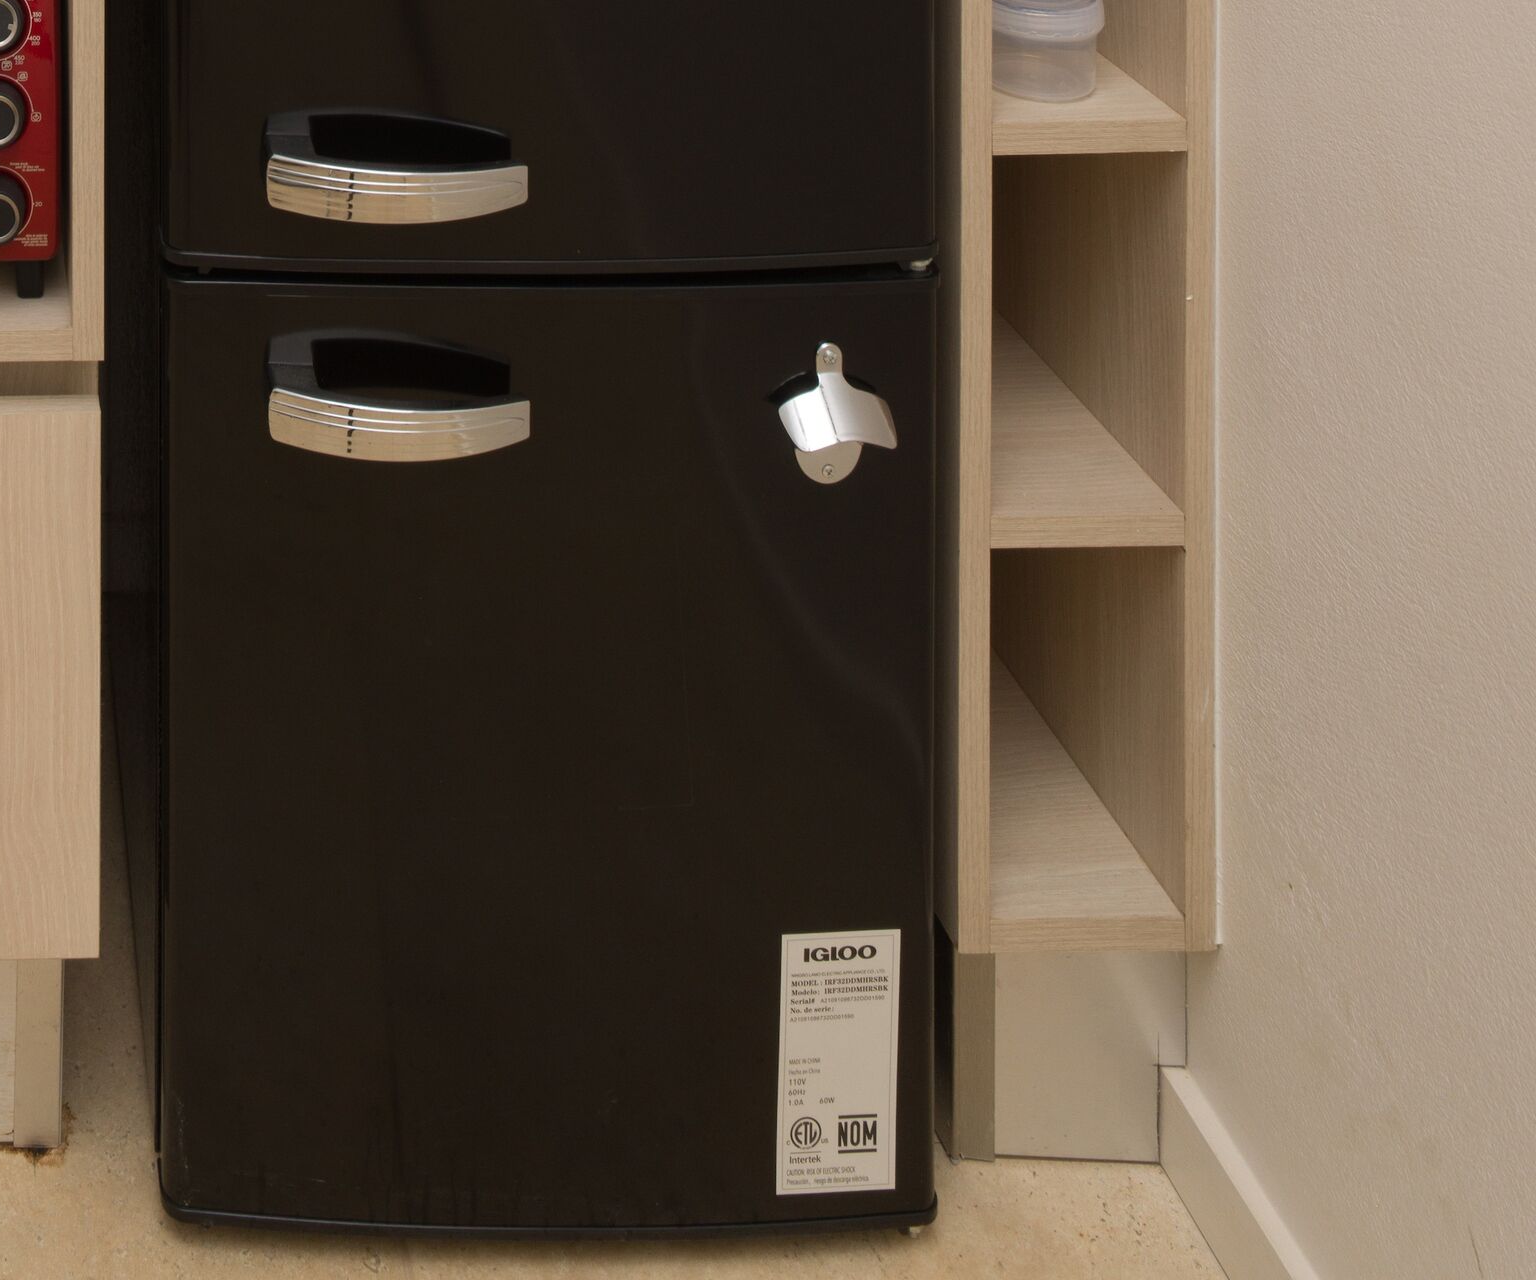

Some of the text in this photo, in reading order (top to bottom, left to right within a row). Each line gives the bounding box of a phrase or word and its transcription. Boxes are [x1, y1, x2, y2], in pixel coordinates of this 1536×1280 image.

[803, 945, 877, 963] IGLOO
[790, 998, 815, 1006] Serial#
[789, 1078, 806, 1086] 110V
[794, 1121, 818, 1146] ETL
[838, 1120, 877, 1147] NOM
[789, 1155, 821, 1164] Intertek
[822, 1167, 840, 1175] ELECTRIC
